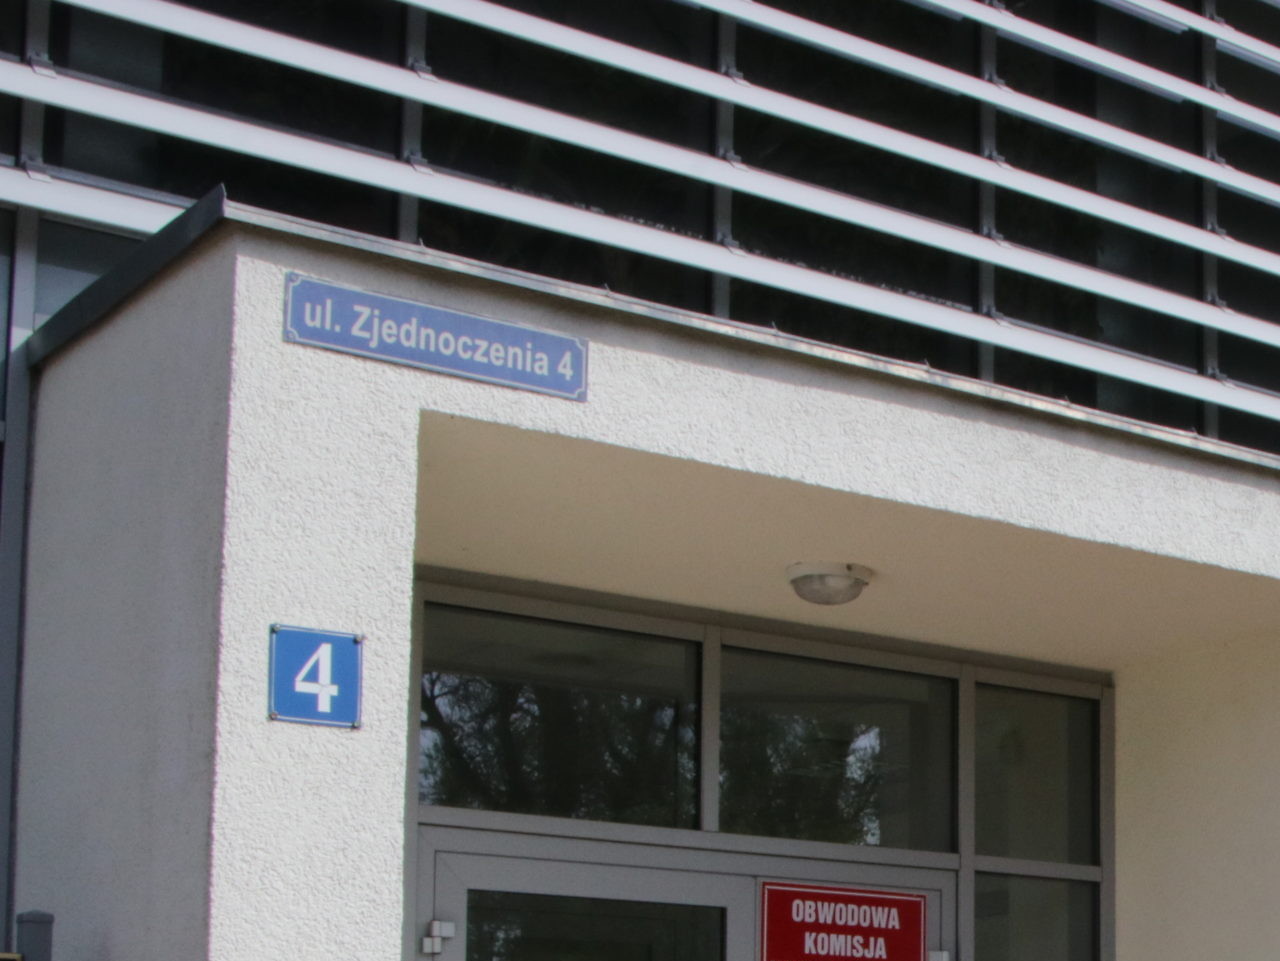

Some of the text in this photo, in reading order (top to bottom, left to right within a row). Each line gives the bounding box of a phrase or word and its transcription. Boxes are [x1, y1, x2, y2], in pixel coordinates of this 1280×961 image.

[303, 298, 574, 381] ul. Zjednoczenia 4
[294, 642, 339, 713] 4
[791, 899, 901, 930] OBWODOWA
[804, 932, 887, 959] KOMISJA
